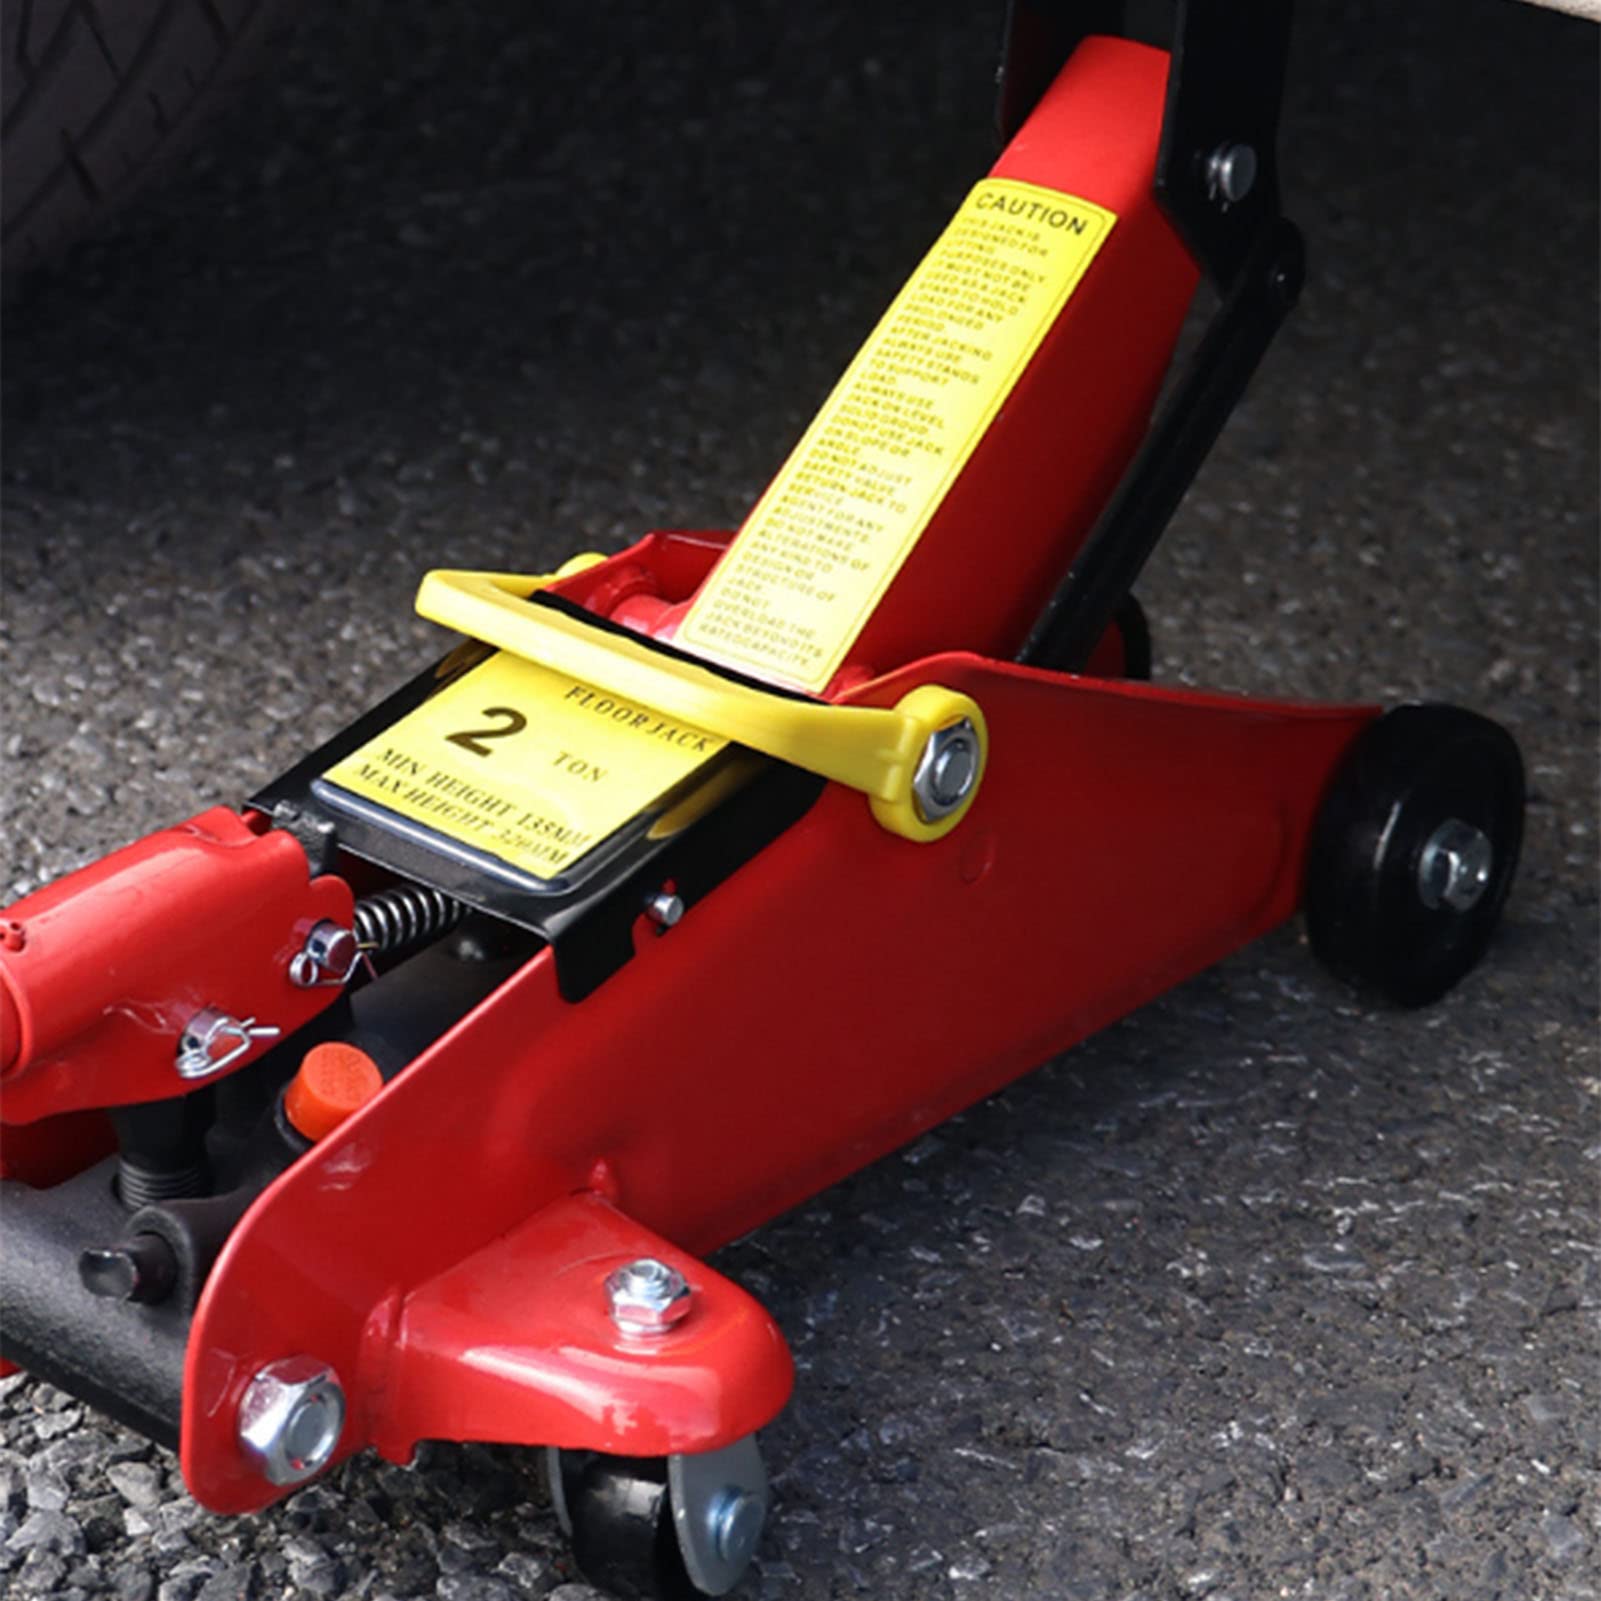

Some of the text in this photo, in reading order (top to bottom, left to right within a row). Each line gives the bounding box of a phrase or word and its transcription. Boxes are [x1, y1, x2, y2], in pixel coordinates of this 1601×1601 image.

[975, 192, 1088, 236] CAUTION
[445, 706, 528, 758] 2
[564, 687, 714, 753] FLOOR JACK
[377, 748, 426, 777] MIN
[426, 771, 516, 818] HEIGHT
[552, 751, 607, 783] TON
[355, 763, 405, 795] MAX
[404, 789, 494, 831] HEIGHT
